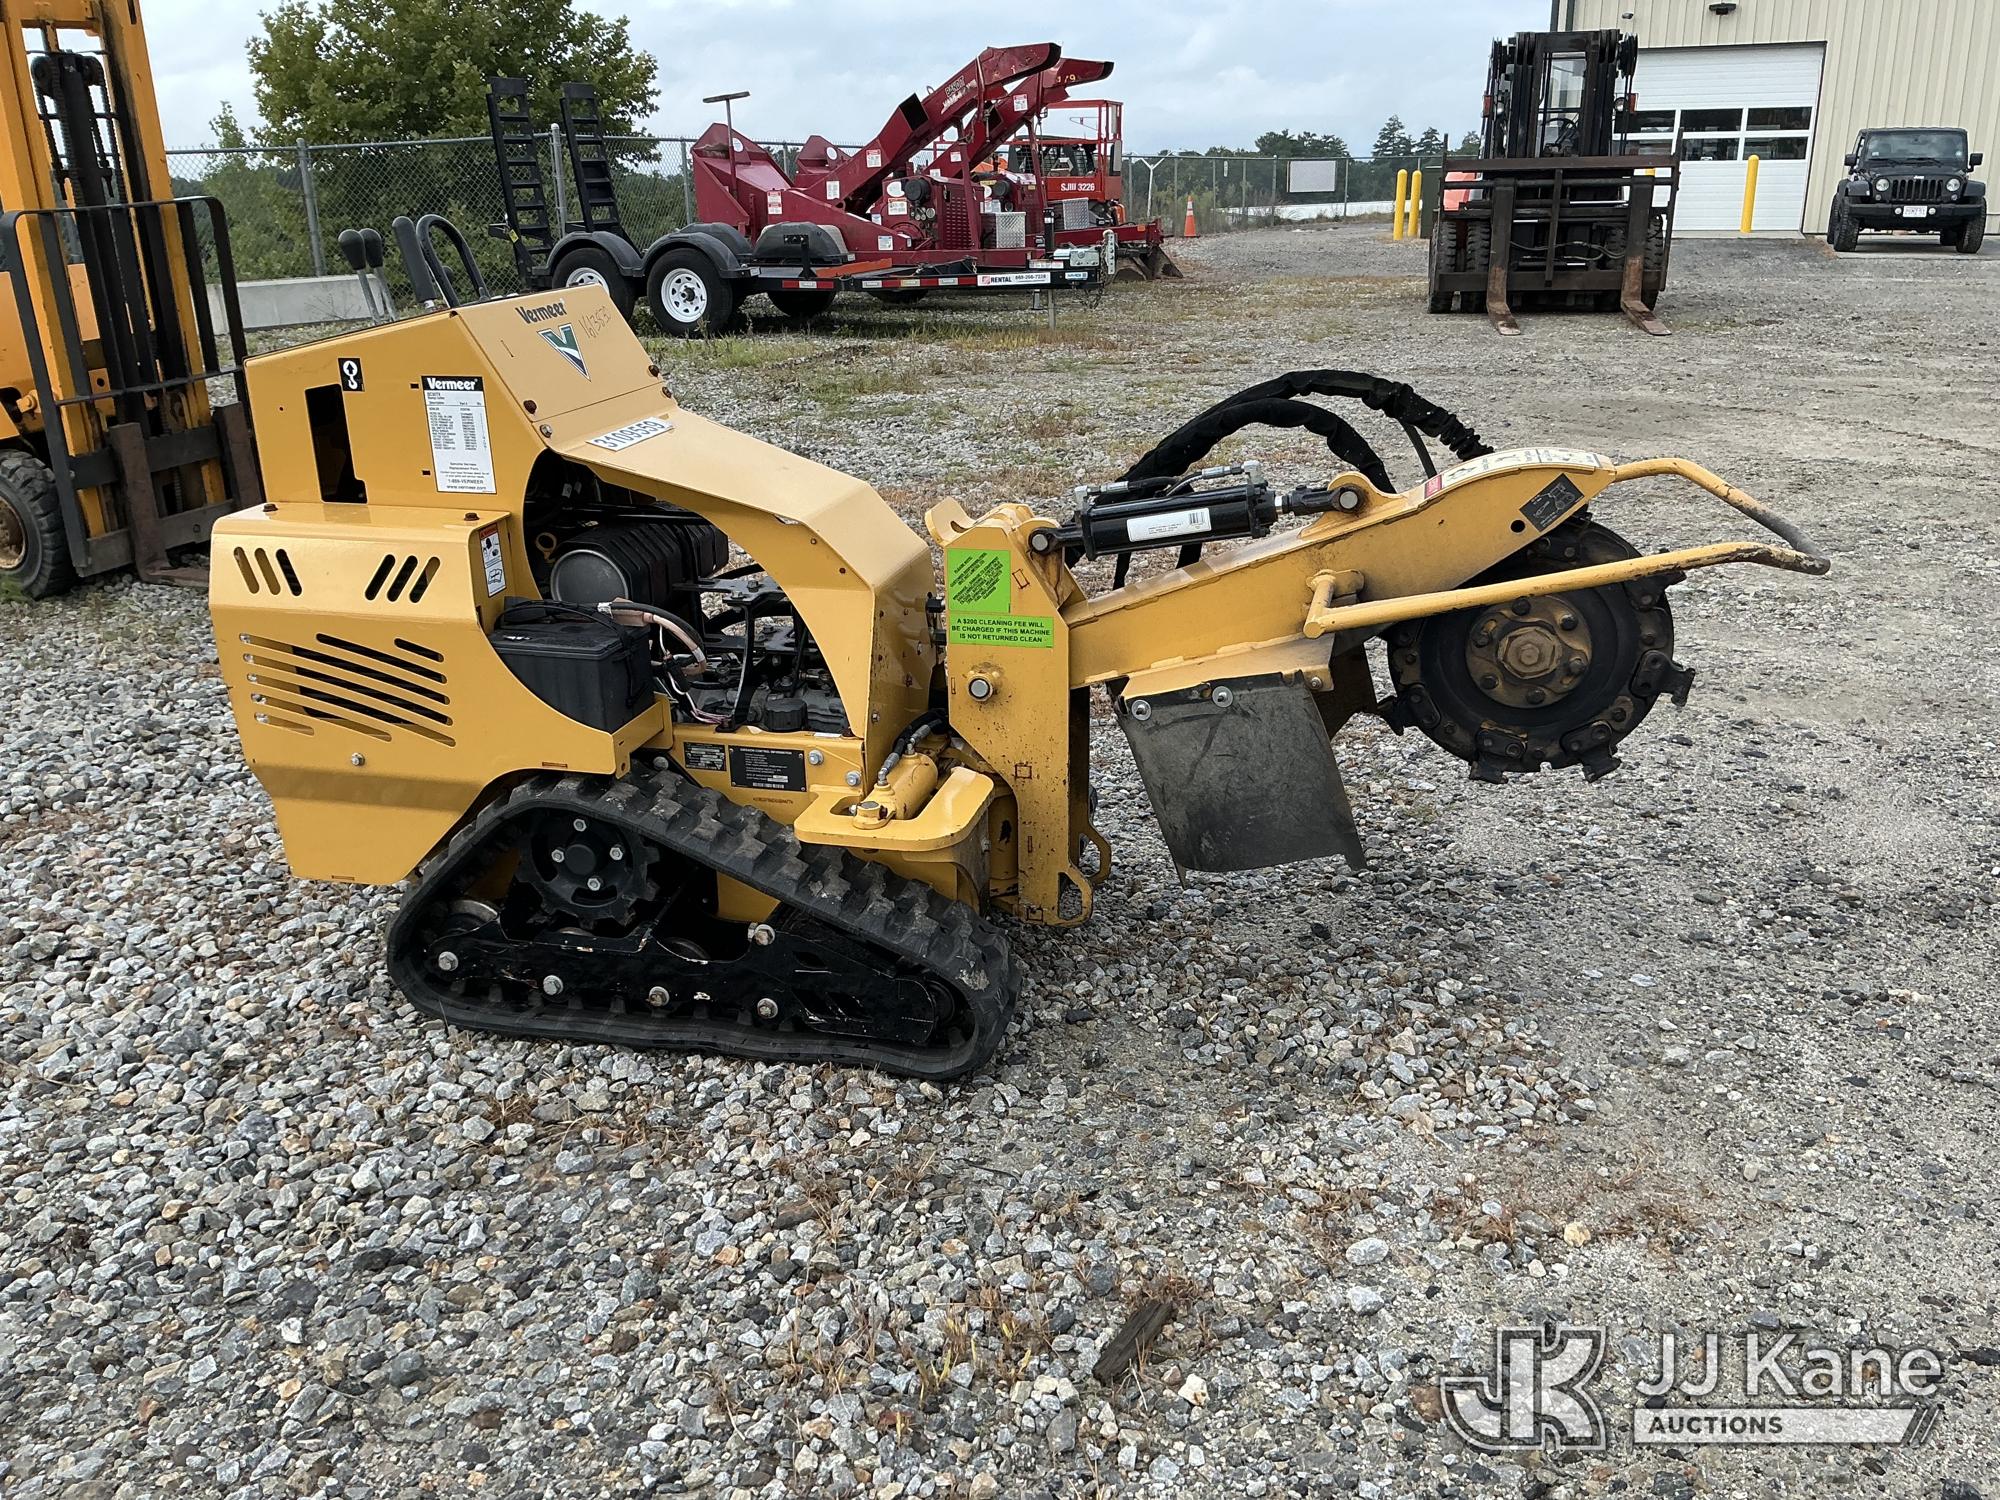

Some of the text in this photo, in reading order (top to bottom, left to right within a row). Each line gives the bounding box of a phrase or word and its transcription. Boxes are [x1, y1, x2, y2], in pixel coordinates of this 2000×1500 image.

[1077, 183, 1095, 192] 3226
[990, 276, 1012, 284] RENTAL
[515, 301, 567, 324] Vermeer
[426, 377, 476, 390] Vermeer
[594, 421, 665, 448] 3109559
[978, 619, 1013, 627] CLEANING
[961, 625, 995, 633] CHARGED
[1019, 628, 1051, 636] MACHINE
[982, 634, 1019, 642] RETURNED
